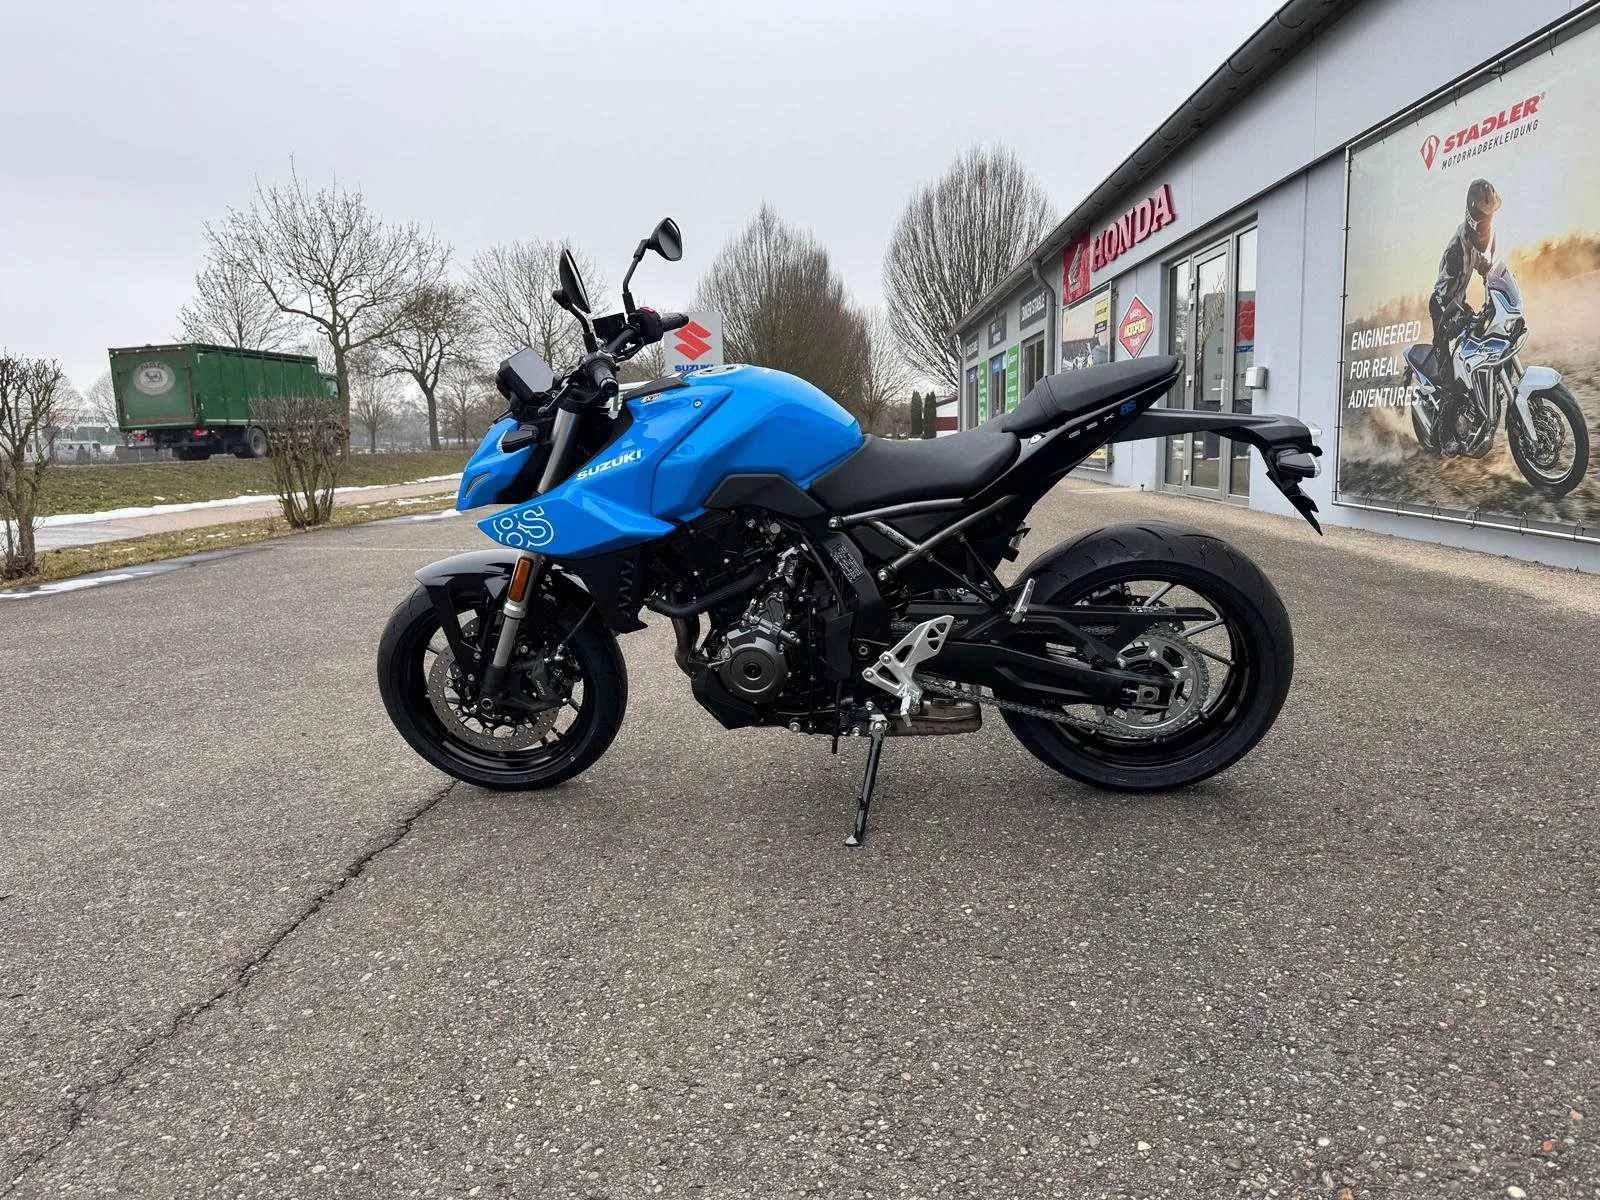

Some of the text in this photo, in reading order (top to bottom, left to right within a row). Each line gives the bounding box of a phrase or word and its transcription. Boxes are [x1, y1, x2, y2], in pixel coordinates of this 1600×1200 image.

[1443, 95, 1541, 154] STADLER
[1441, 119, 1539, 170] MOTORRADBEKLEIDUNG
[1090, 184, 1176, 272] HONDA
[1351, 321, 1421, 351] ENGINEERED
[1350, 356, 1400, 379] FOR REAL
[1348, 385, 1422, 408] ADVENTURES.
[576, 448, 642, 481] SUZUKI
